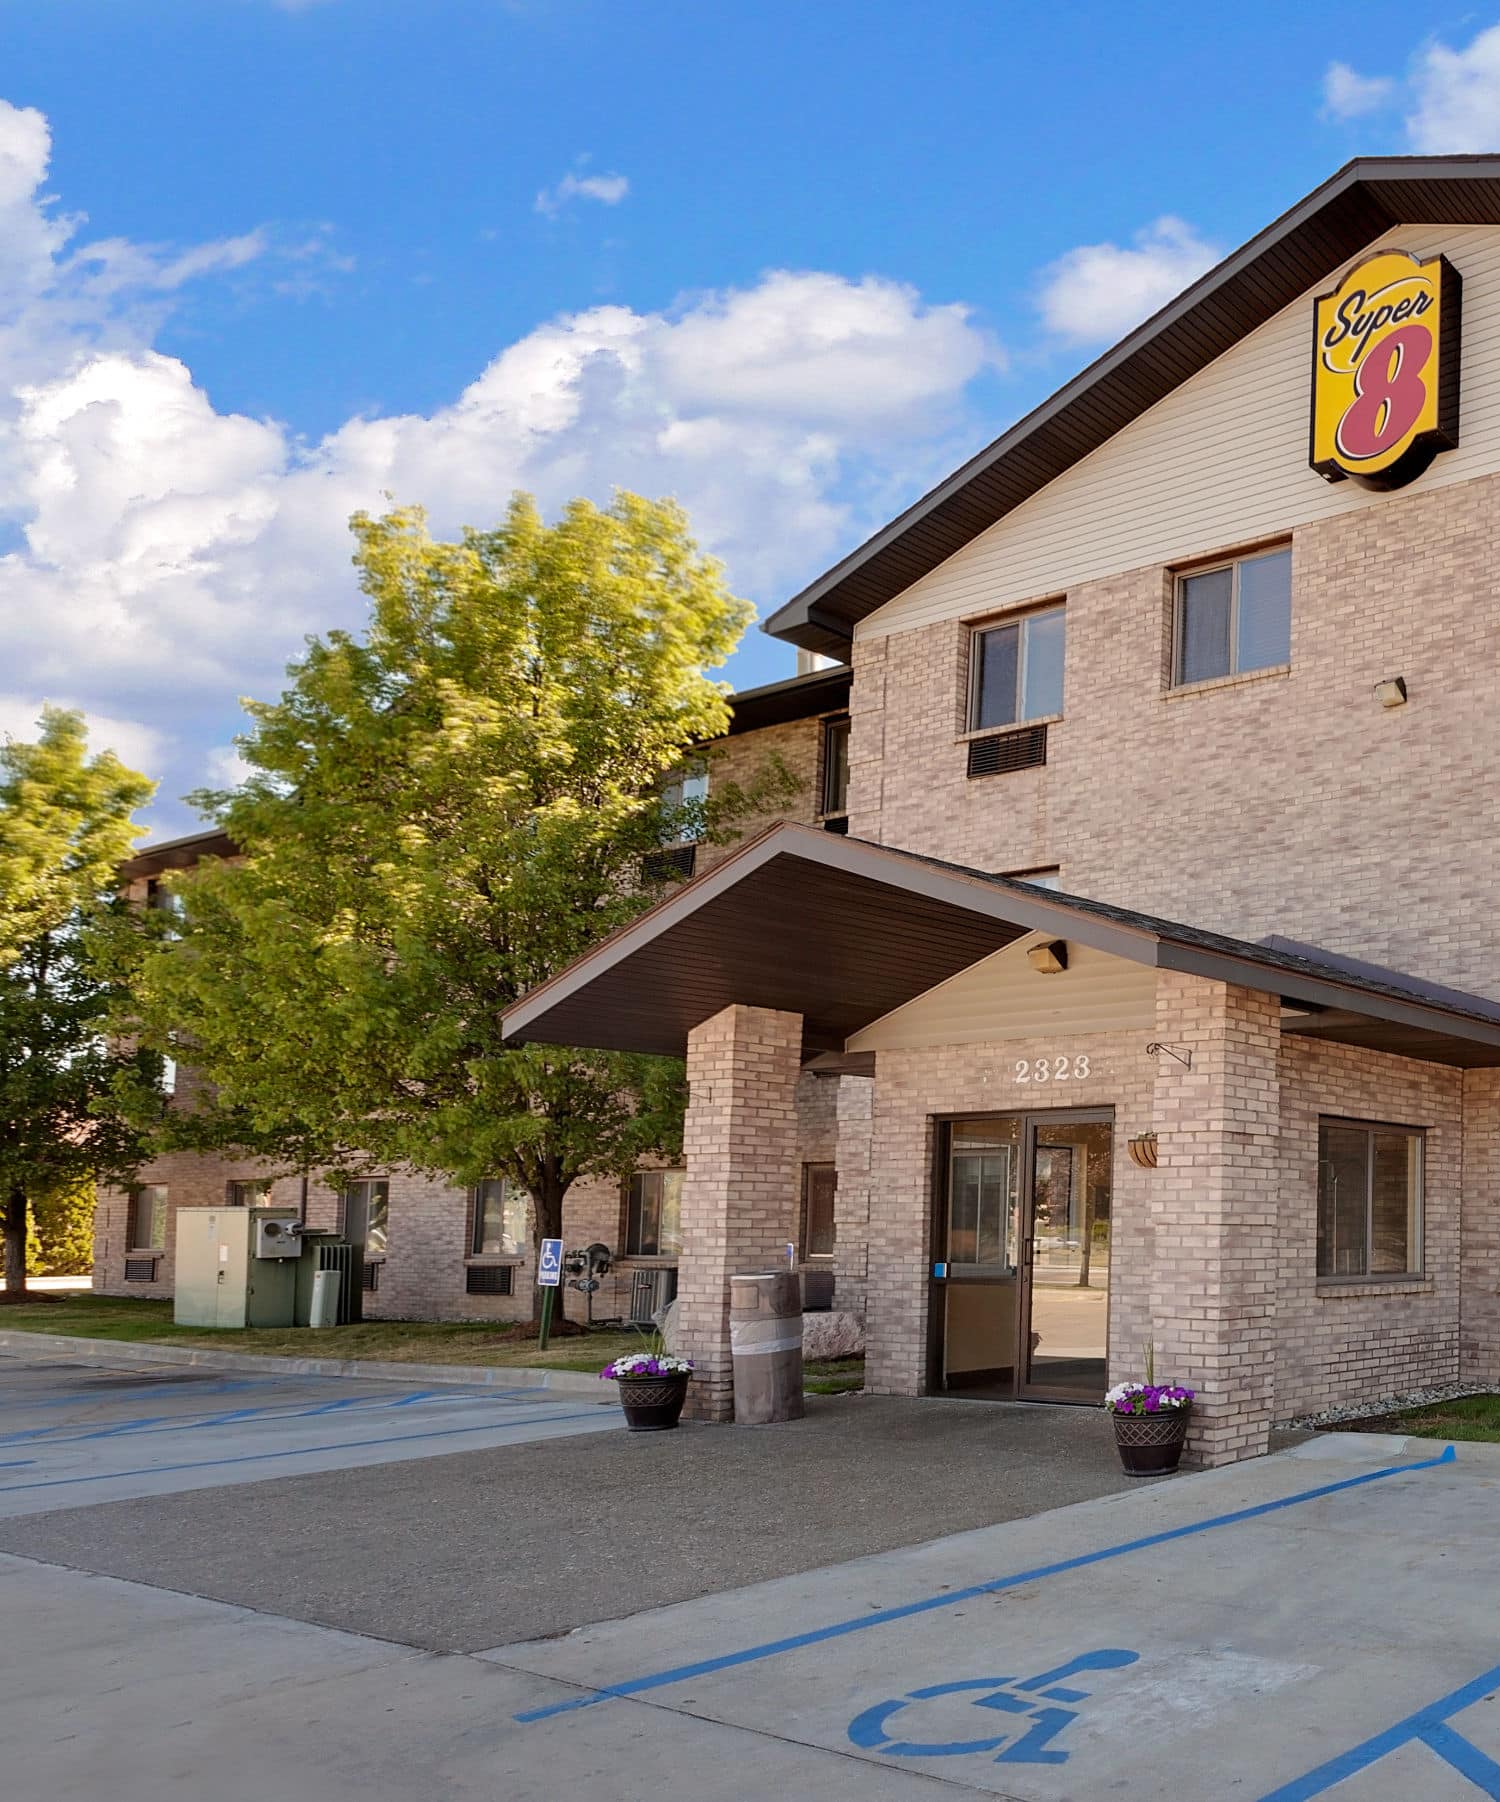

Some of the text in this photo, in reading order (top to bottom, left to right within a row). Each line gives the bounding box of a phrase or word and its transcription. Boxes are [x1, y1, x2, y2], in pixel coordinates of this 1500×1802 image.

[1323, 289, 1434, 364] Super
[1335, 324, 1433, 461] 8
[1014, 1055, 1091, 1083] 2323
